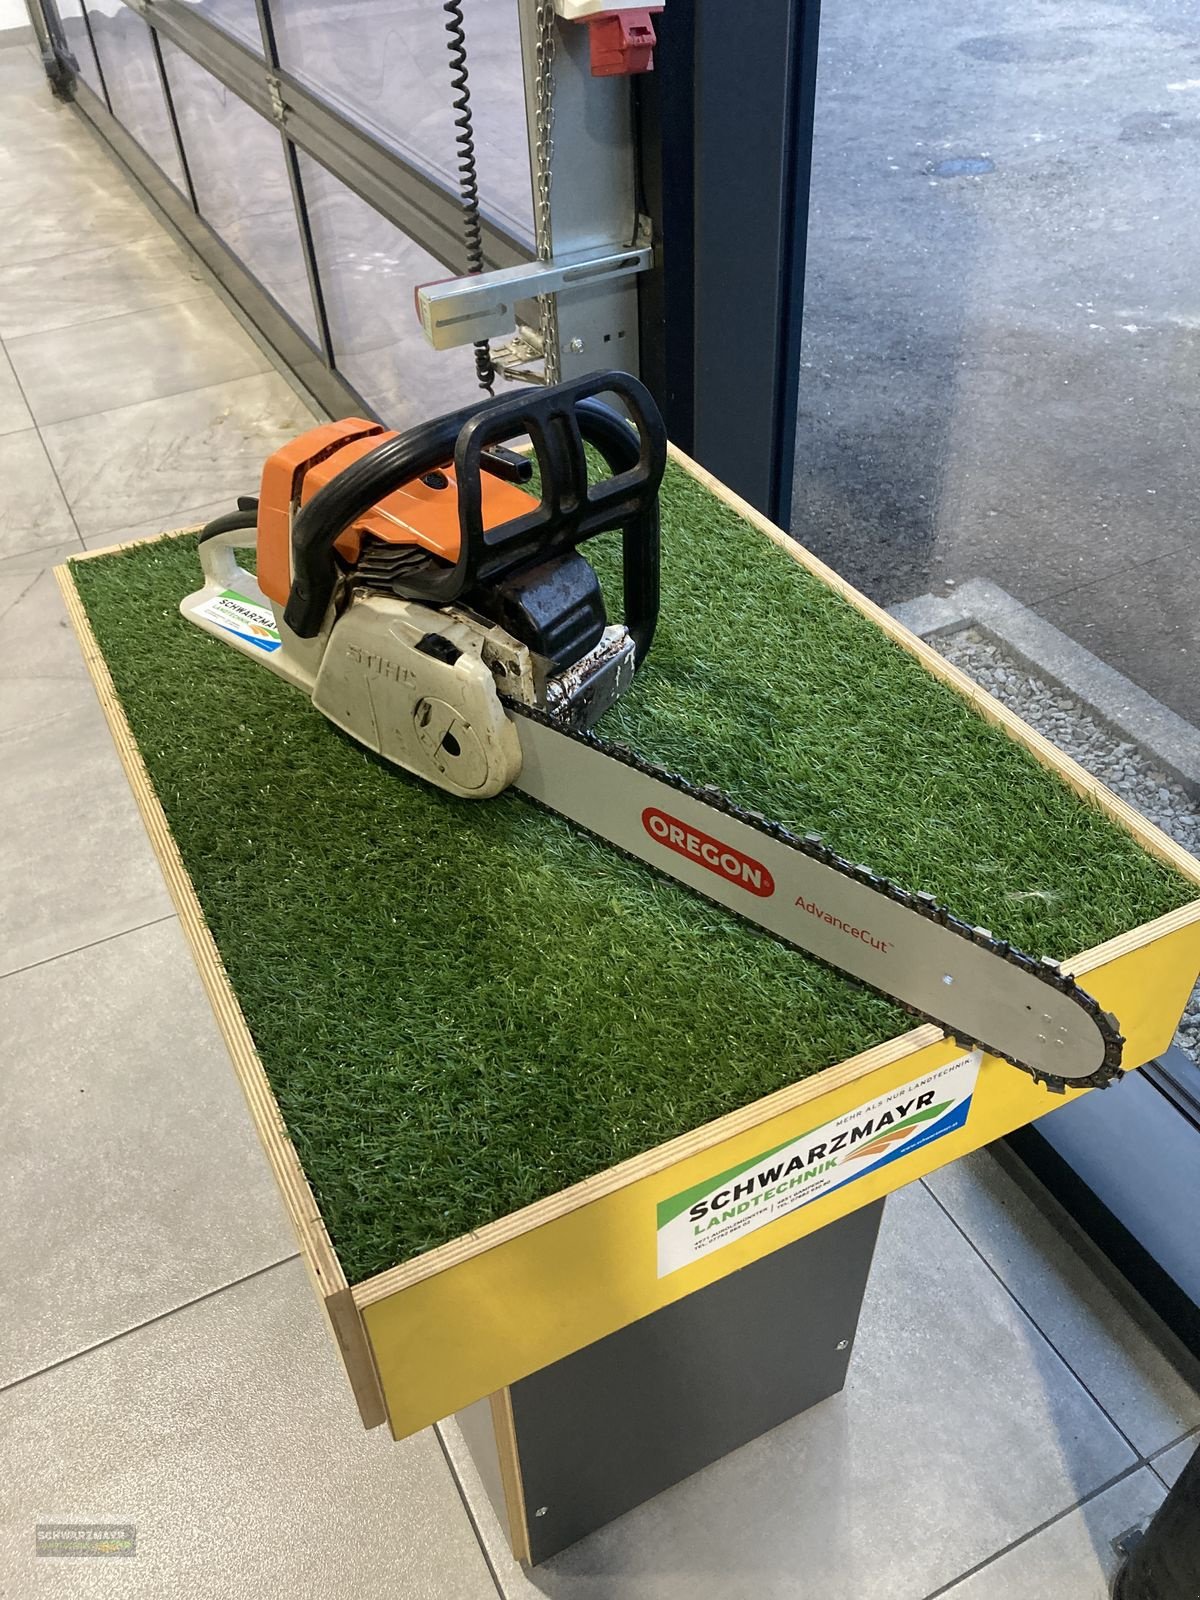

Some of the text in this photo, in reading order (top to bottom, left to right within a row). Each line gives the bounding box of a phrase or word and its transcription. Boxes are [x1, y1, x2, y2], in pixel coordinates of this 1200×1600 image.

[649, 815, 763, 890] OREGON
[836, 1058, 973, 1127] MEHR ALS NUR LANDTECHNIK.
[689, 1090, 936, 1222] SCHWARZMAYR
[694, 1157, 838, 1236] LANDTECHNIK
